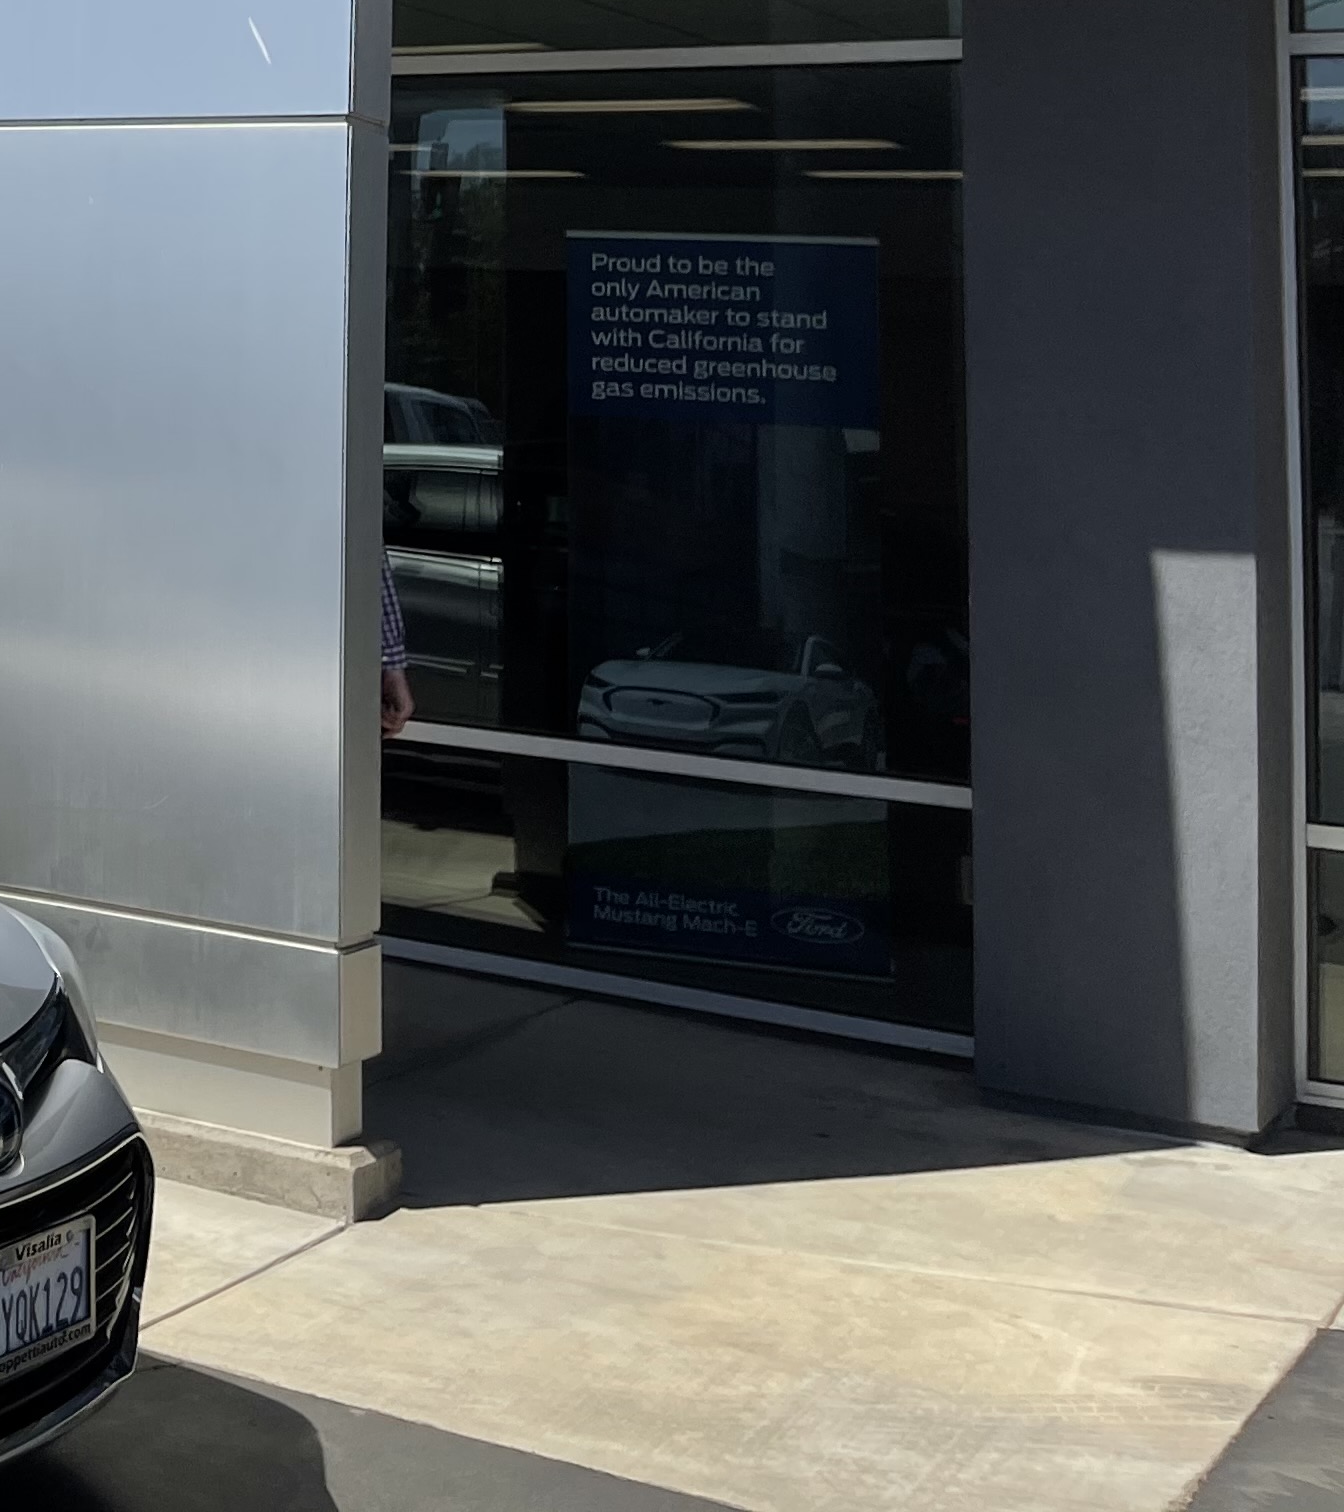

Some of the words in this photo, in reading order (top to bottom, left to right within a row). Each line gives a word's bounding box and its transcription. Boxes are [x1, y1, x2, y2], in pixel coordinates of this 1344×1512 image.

[592, 252, 661, 273] Proud
[667, 255, 692, 274] to
[698, 255, 729, 275] be
[736, 256, 775, 277] the
[592, 278, 640, 301] only
[646, 279, 760, 302] American
[591, 304, 719, 326] automaker
[725, 308, 750, 327] to
[757, 309, 827, 329] stand
[592, 327, 642, 348] with
[648, 329, 764, 353] California
[769, 332, 805, 354] for
[592, 353, 687, 375] reduced
[693, 358, 837, 383] greenhouse
[592, 381, 634, 400] gas
[640, 380, 766, 405] emissions.
[593, 886, 630, 907] The
[593, 904, 678, 933] Mustang
[683, 914, 759, 938] Mach-E
[785, 911, 848, 940] Ford
[15, 1232, 62, 1261] Visalia
